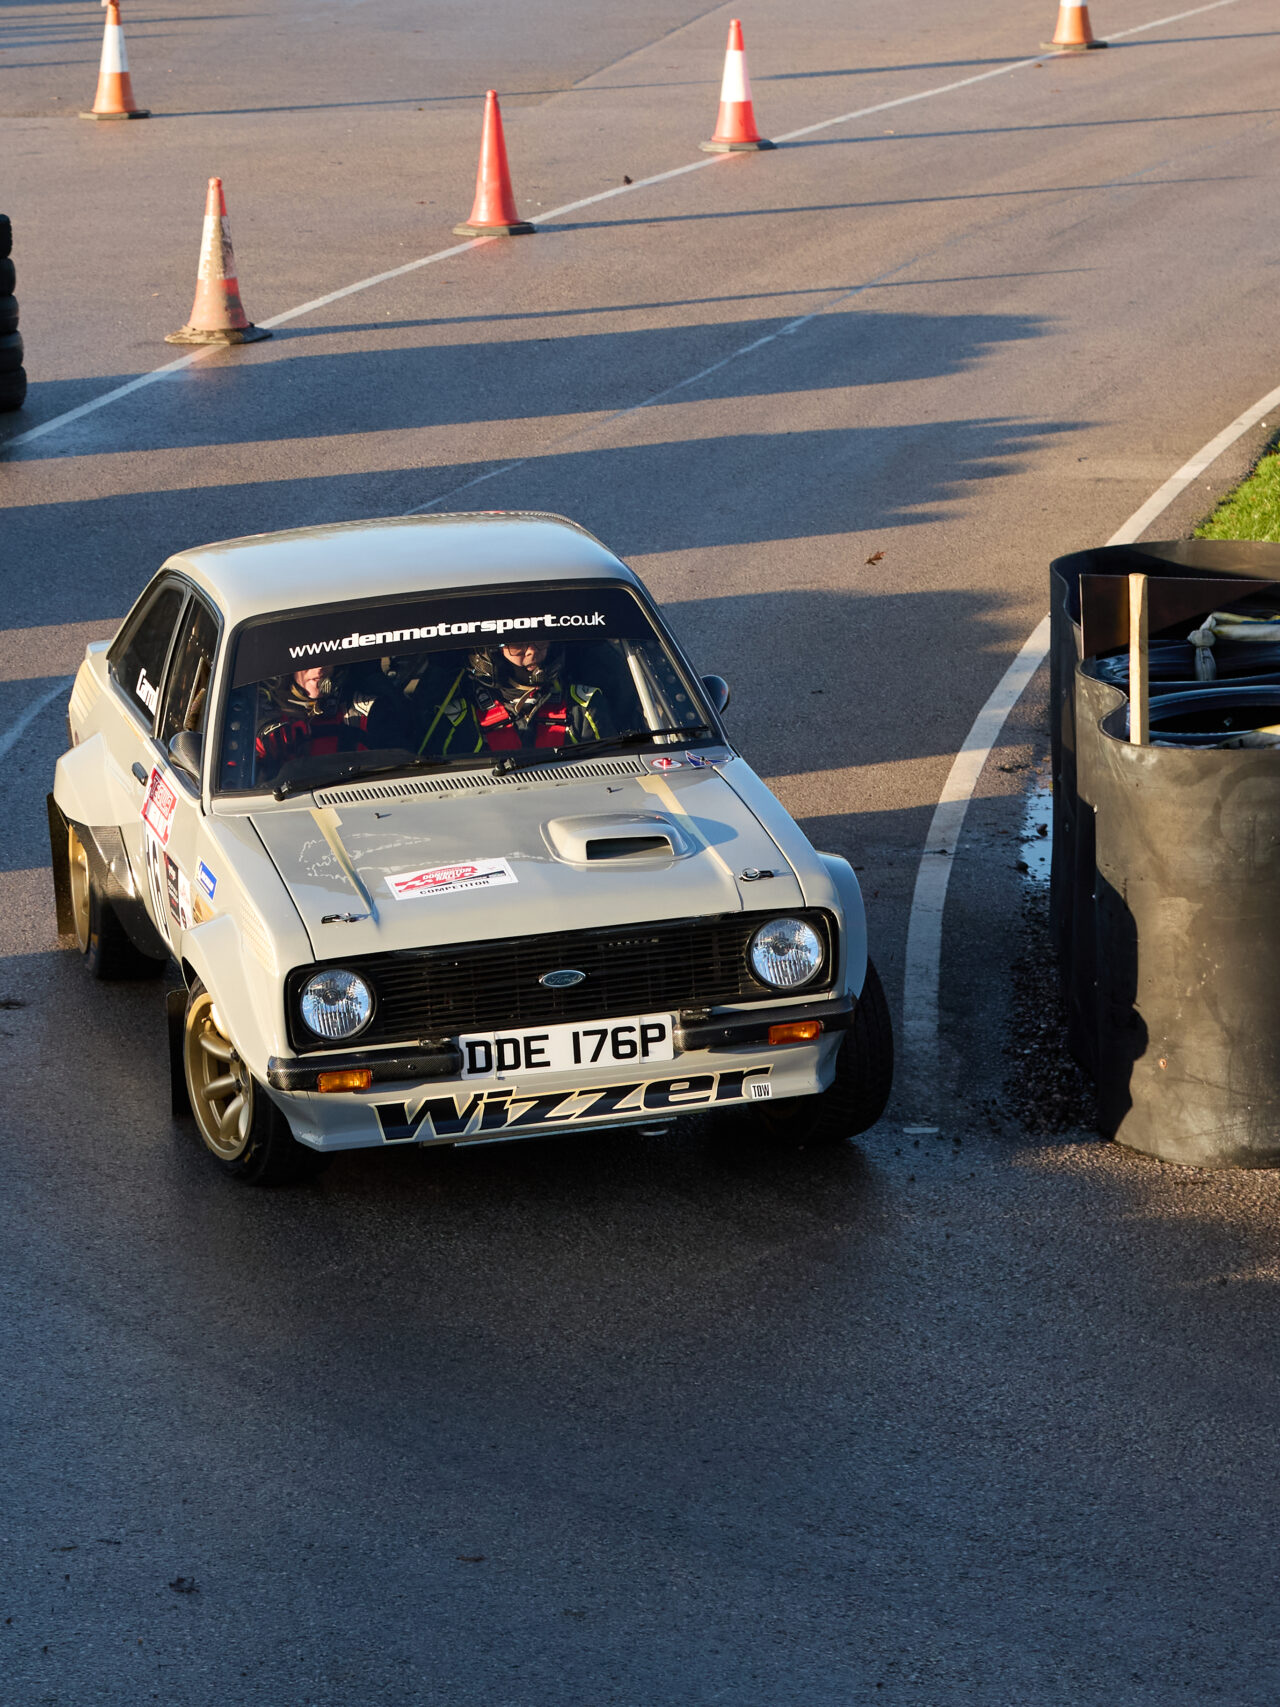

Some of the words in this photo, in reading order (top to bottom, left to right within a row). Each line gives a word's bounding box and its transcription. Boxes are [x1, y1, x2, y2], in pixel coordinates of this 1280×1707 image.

[289, 612, 606, 658] www.denmotorsport.co.uk
[420, 880, 489, 894] COMPETITOR
[466, 1034, 551, 1074] DDE
[573, 1024, 666, 1064] 176P
[371, 1064, 773, 1143] Wizzer
[752, 1084, 770, 1097] TOW
